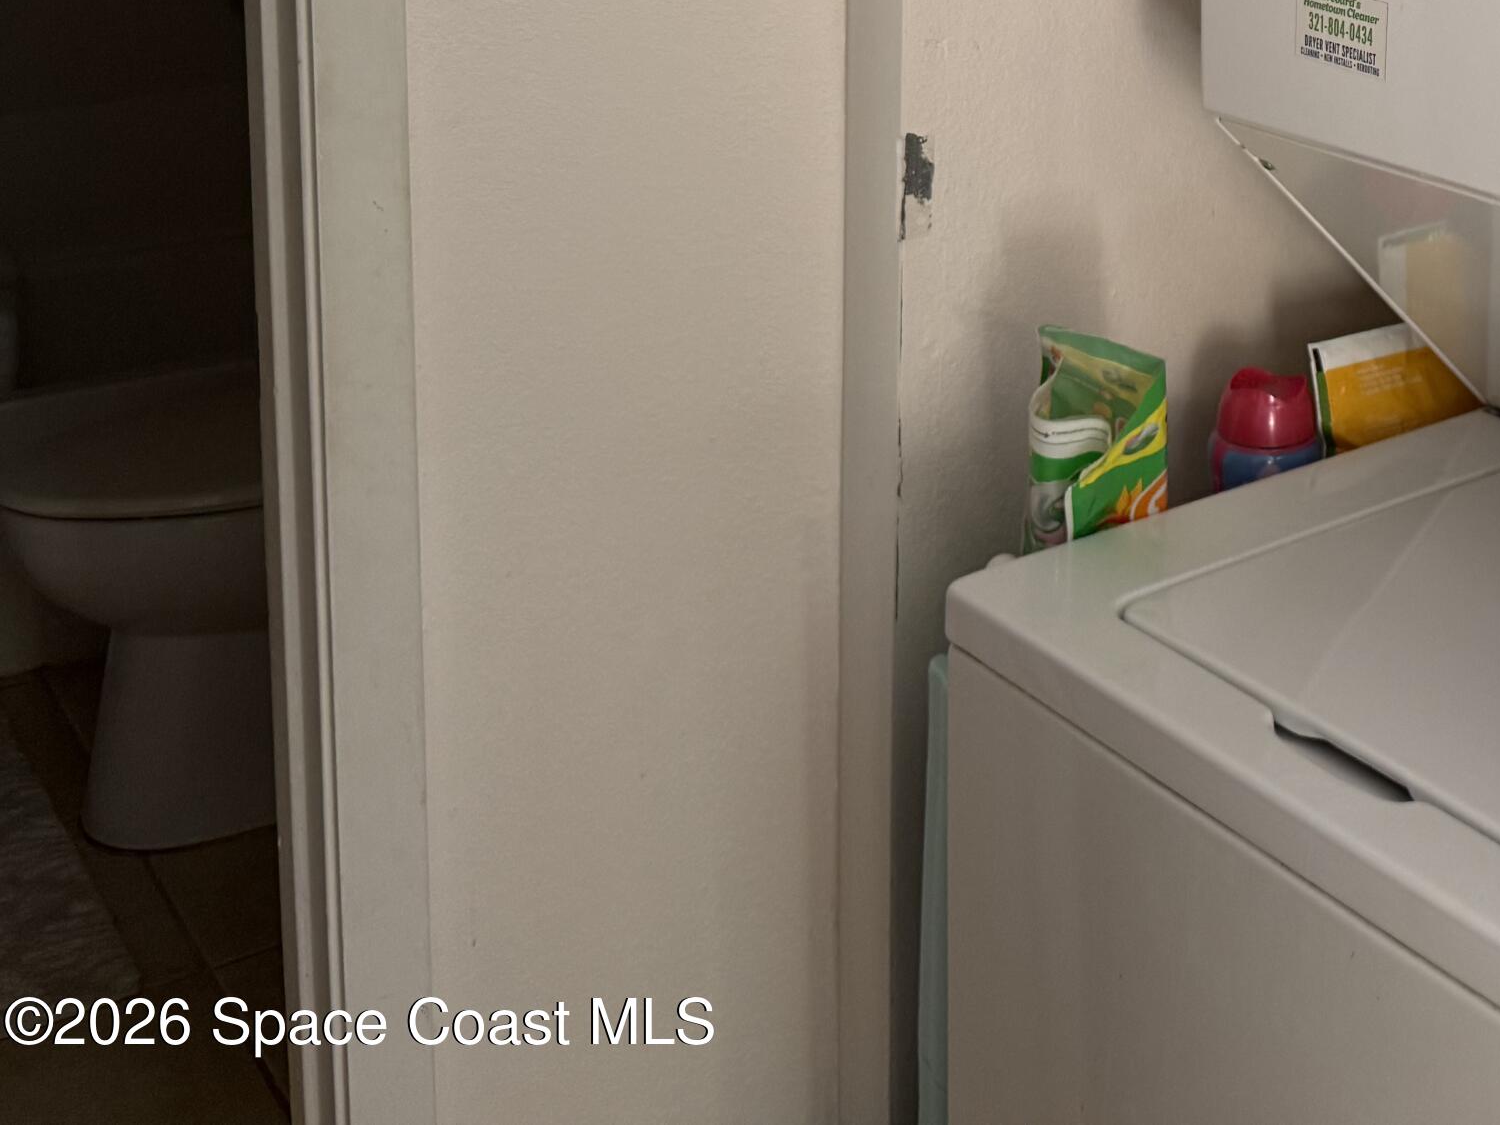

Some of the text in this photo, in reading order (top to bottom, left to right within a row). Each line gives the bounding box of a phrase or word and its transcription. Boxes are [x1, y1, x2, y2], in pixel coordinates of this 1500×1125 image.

[1347, 8, 1379, 24] Cleaner
[1309, 12, 1373, 46] 321-804-0434
[1305, 35, 1376, 66] DRYER VENT SPECIALIST
[1334, 56, 1352, 68] INSTALLS
